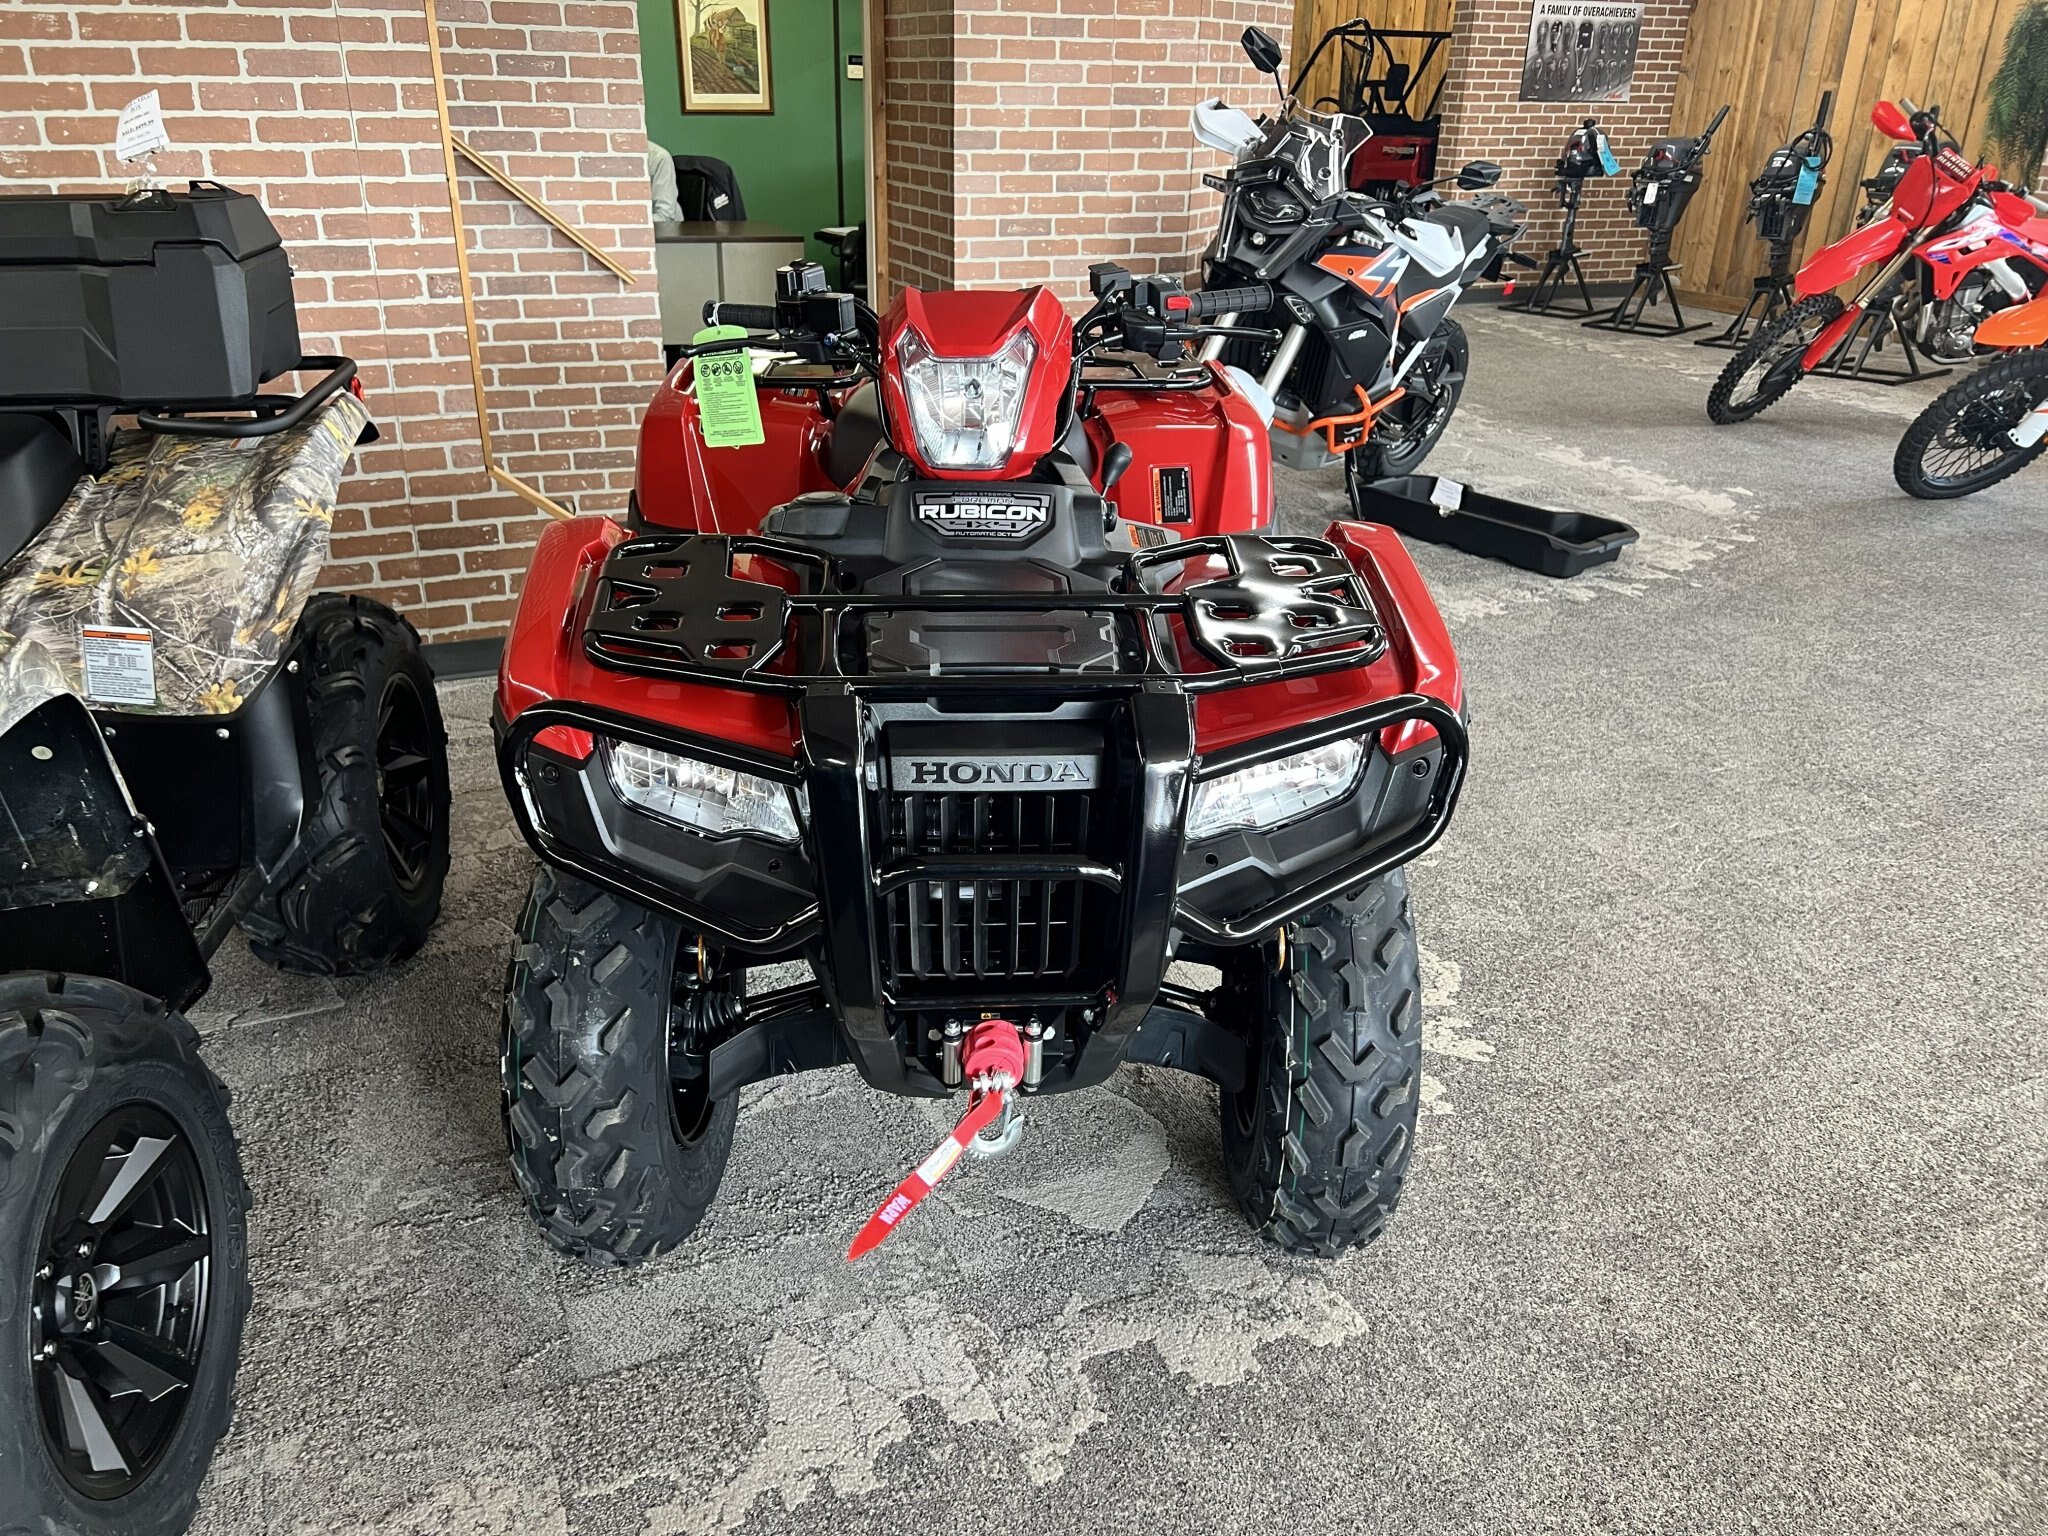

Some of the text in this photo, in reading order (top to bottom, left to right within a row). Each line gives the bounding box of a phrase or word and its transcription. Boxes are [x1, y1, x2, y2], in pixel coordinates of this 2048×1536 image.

[1540, 4, 1637, 18] A FAMILY OF OVERACHIEVERS
[1937, 155, 1968, 178] RENTHAL
[1942, 150, 1973, 174] RENTHAL
[919, 504, 1047, 522] RUBICON
[911, 761, 1090, 784] HONDA
[193, 1093, 244, 1270] MAXXIS
[878, 1192, 912, 1225] WARN
